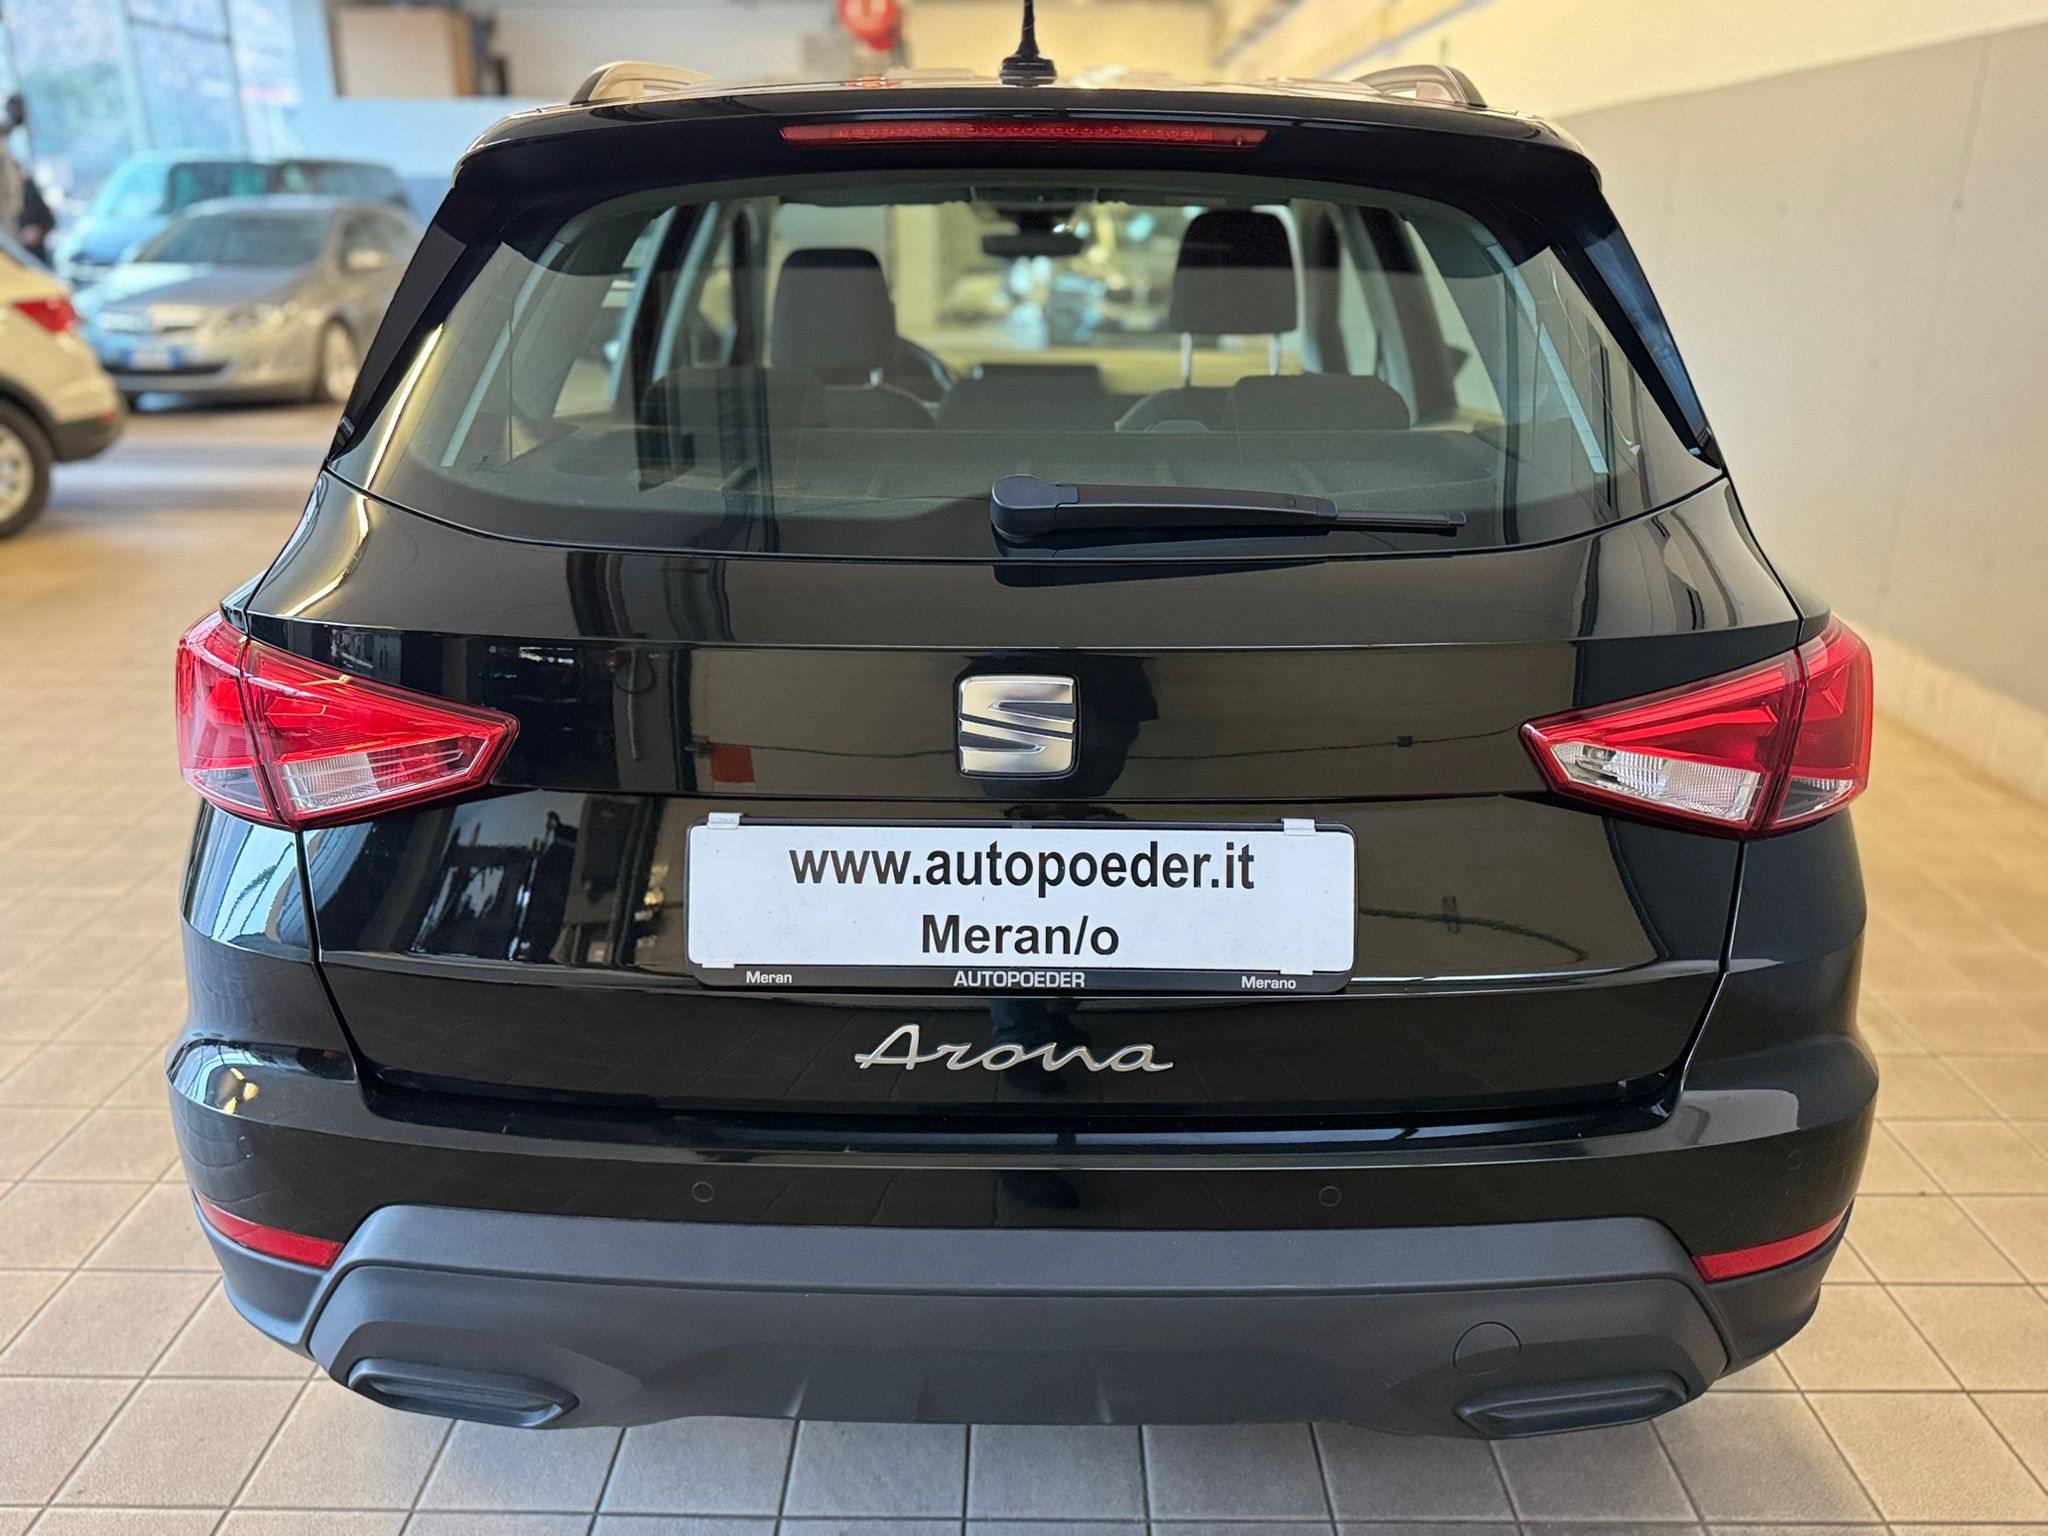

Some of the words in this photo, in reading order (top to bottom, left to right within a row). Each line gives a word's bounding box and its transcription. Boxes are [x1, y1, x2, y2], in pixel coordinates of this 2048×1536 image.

[789, 840, 1255, 899] www.autopoeder.it
[921, 914, 1120, 956] Meran/o
[745, 970, 793, 984] Meran
[953, 970, 1086, 988] AUTOPOEDER
[1241, 975, 1297, 990] Merano
[854, 1023, 1174, 1072] Arona
